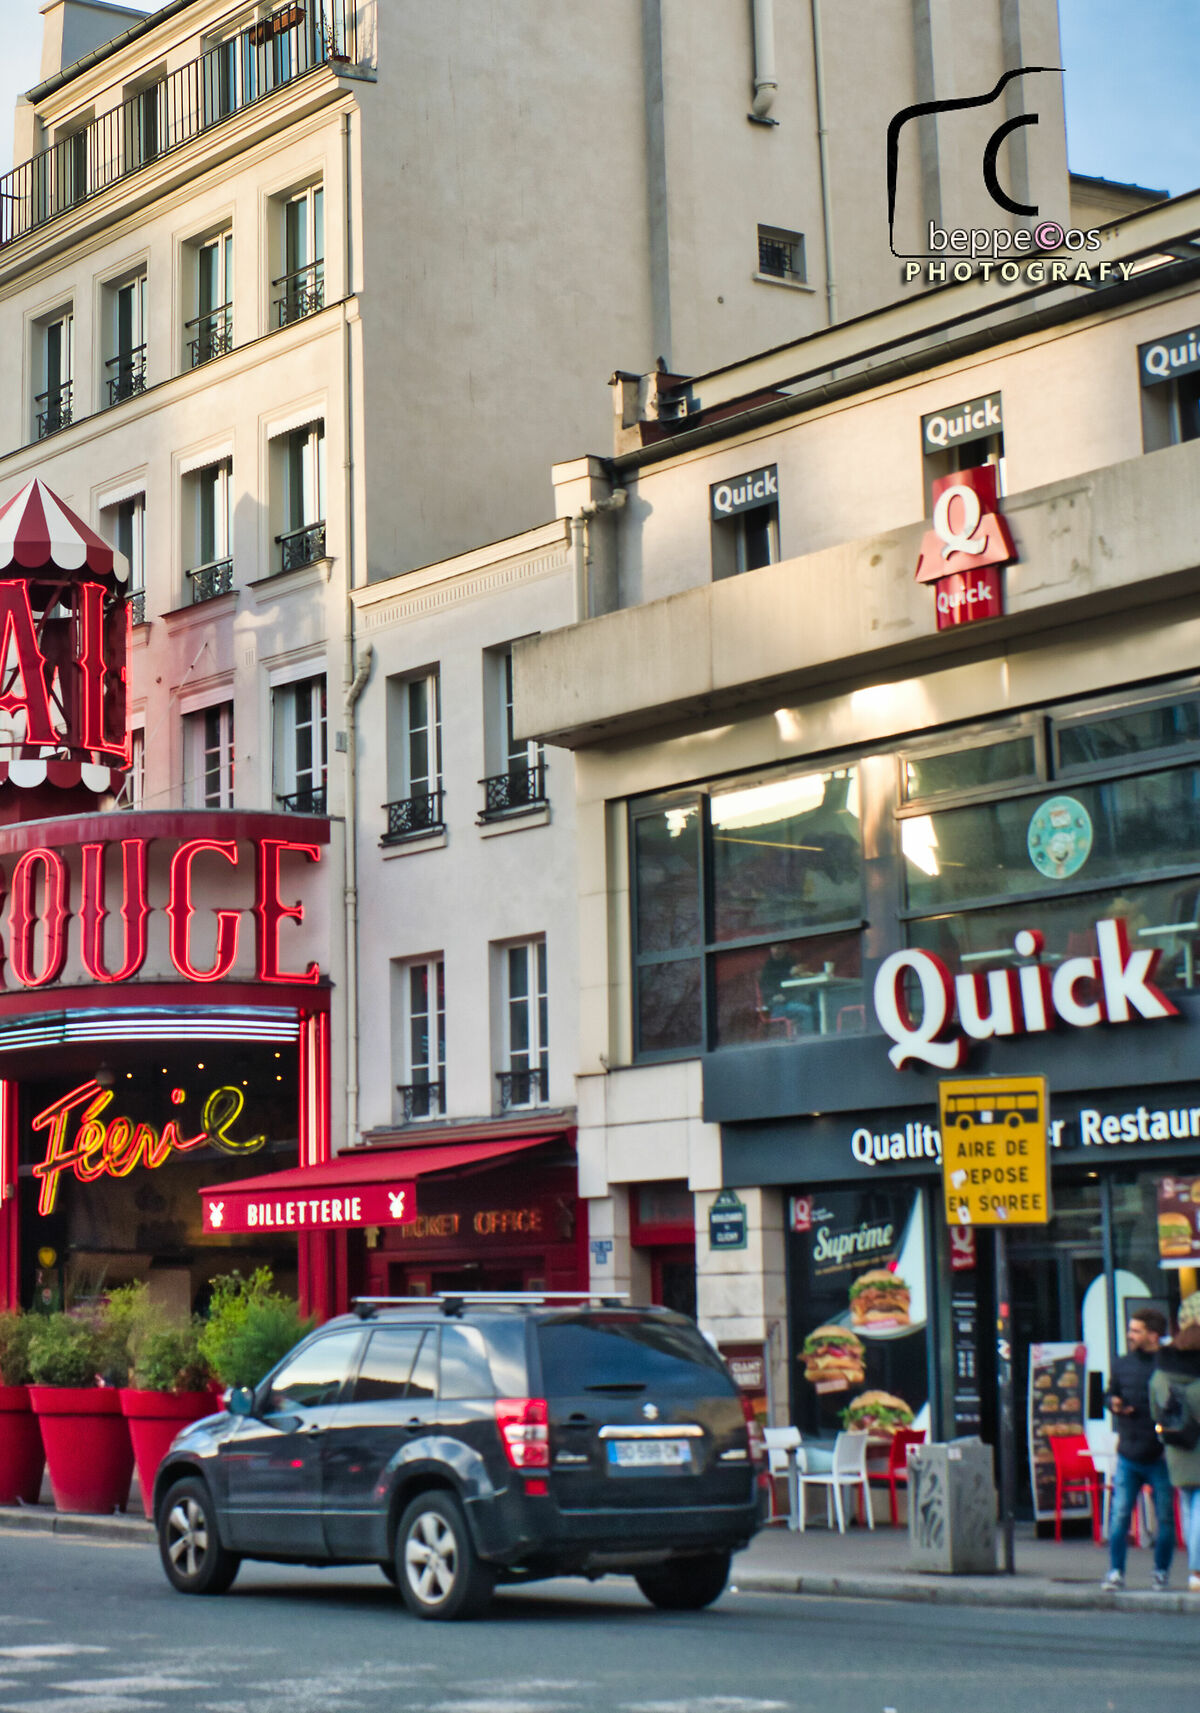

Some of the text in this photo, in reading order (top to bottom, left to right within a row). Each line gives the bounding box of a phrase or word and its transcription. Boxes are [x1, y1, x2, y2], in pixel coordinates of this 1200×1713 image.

[1144, 332, 1200, 377] Qui
[926, 400, 1001, 446] Quick
[714, 471, 777, 513] Quick
[933, 485, 989, 560] Q
[937, 581, 992, 614] Quick
[874, 917, 1180, 1071] Quick
[851, 1122, 942, 1166] Quality
[957, 1139, 1028, 1158] AIRE DE
[247, 1197, 362, 1226] BILLETTERIE
[473, 1209, 543, 1235] OFFICE
[948, 1194, 1042, 1213] EN SOIREE
[813, 1222, 893, 1264] Suprême
